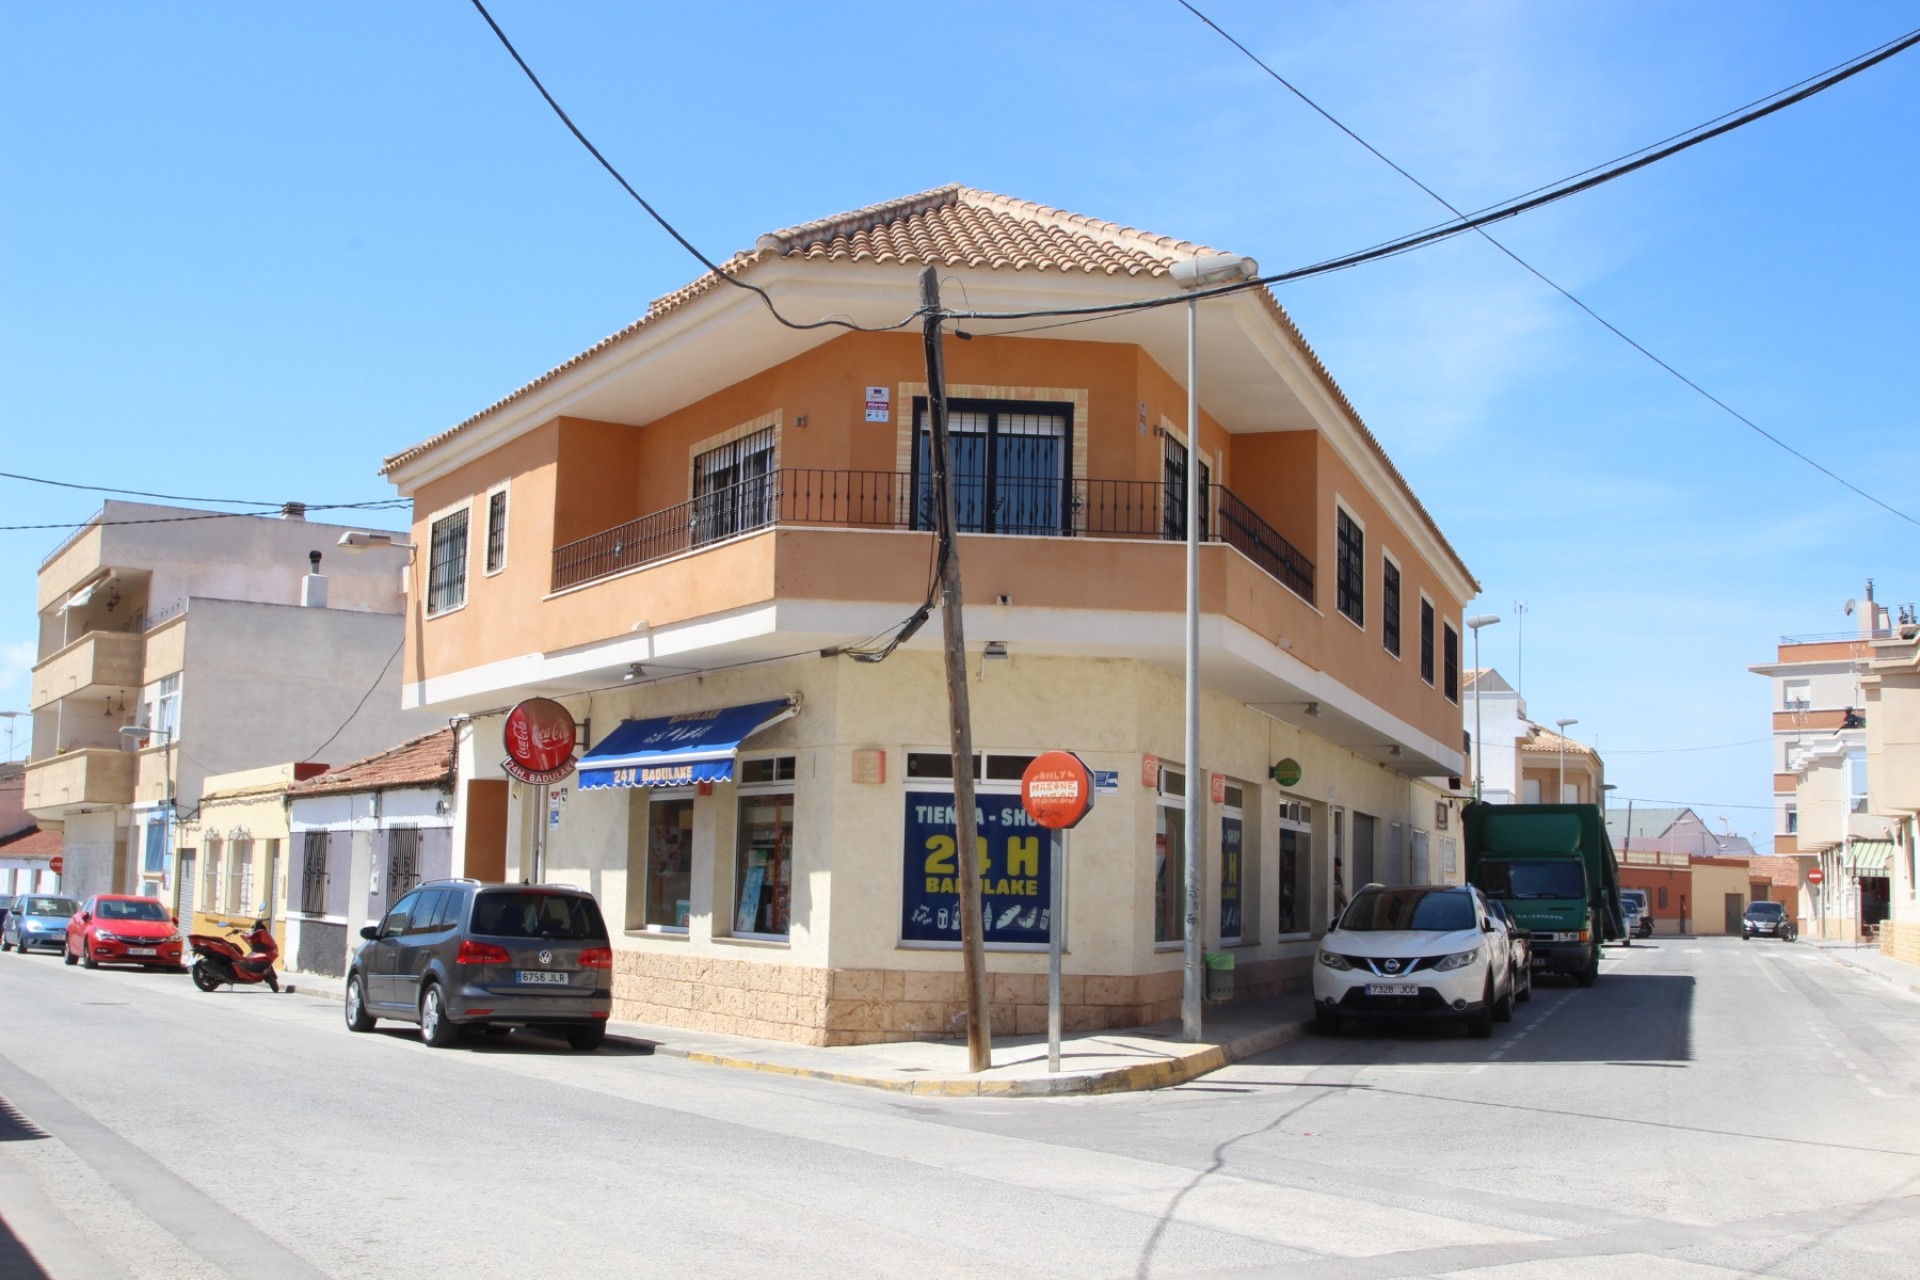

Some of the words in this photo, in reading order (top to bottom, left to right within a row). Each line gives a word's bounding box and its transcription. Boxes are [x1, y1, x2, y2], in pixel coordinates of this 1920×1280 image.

[642, 766, 693, 781] BADULAKE
[915, 806, 984, 825] TIENA
[1007, 836, 1039, 877] H
[523, 972, 546, 982] 6756
[549, 973, 565, 982] JLR
[1372, 985, 1394, 994] 7328
[1400, 985, 1415, 994] JCC
